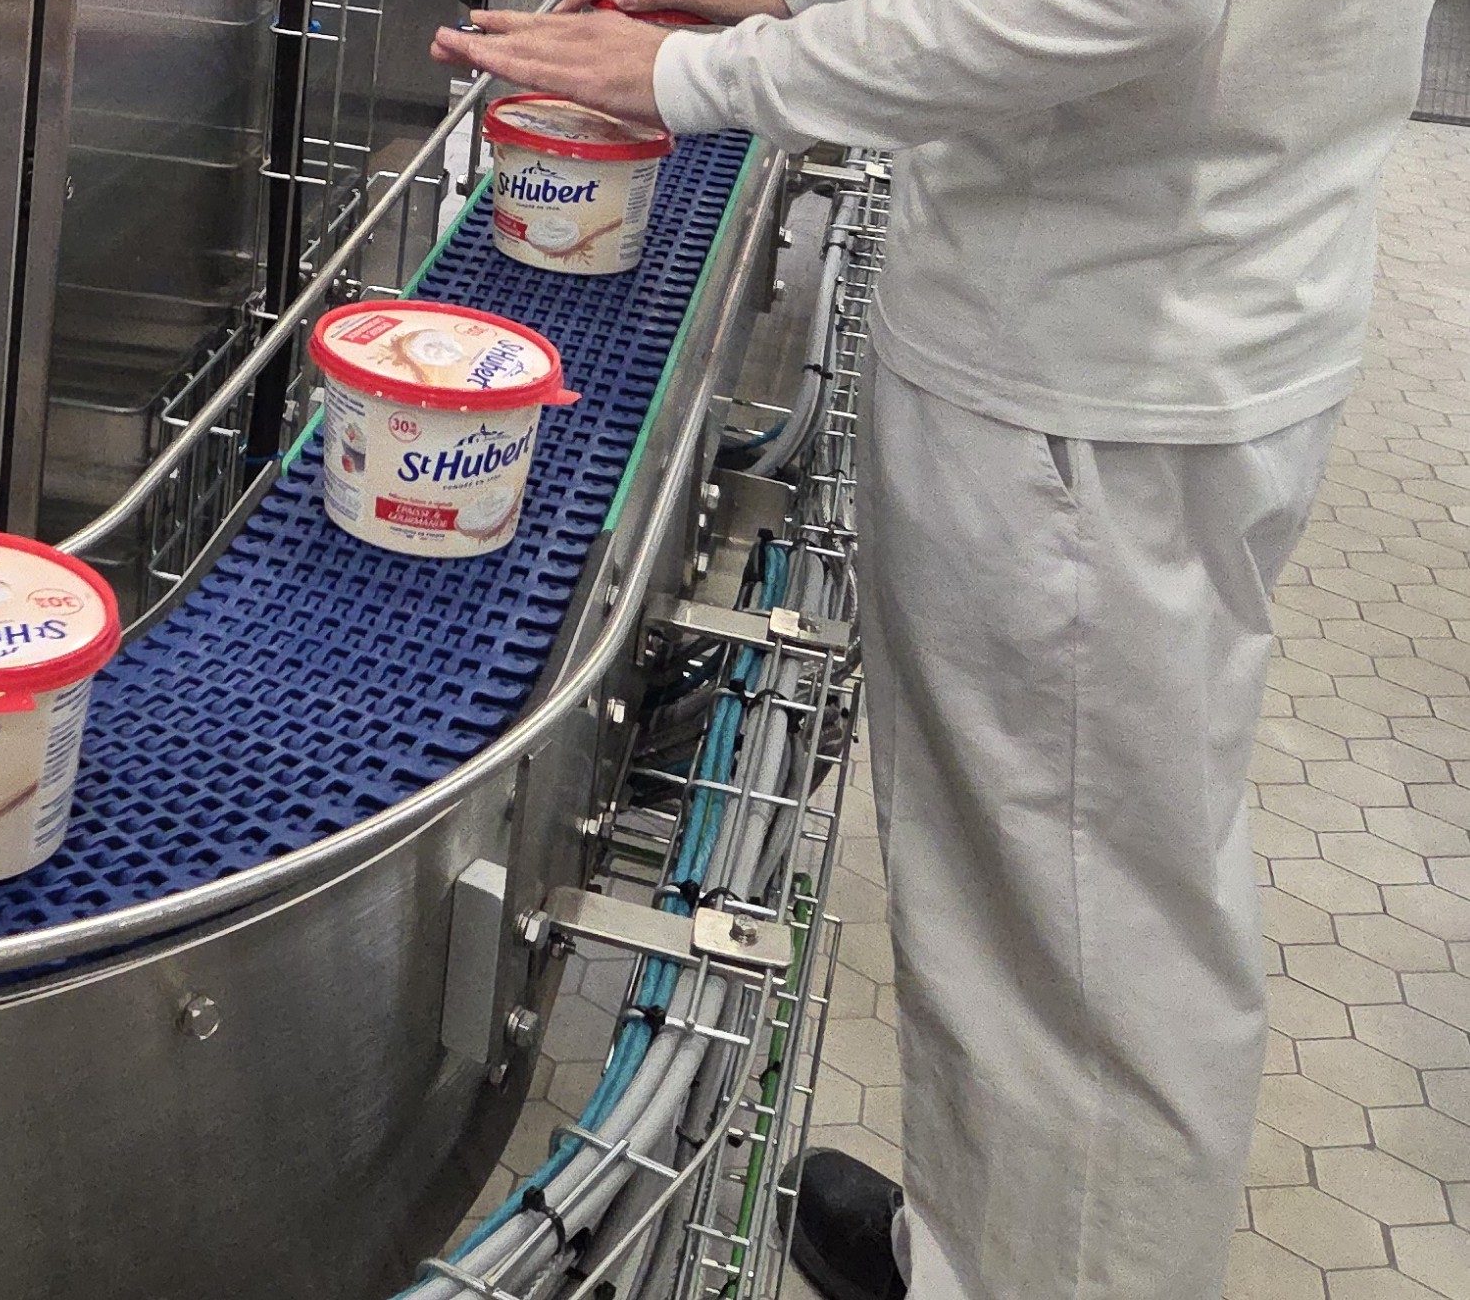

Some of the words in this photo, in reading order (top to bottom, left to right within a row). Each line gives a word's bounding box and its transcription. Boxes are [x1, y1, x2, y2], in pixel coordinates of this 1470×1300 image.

[497, 171, 510, 195] St
[510, 174, 600, 203] Hubert
[466, 347, 518, 388] Hubert
[397, 451, 432, 482] St
[432, 425, 534, 481] Hubert
[33, 619, 67, 639] St
